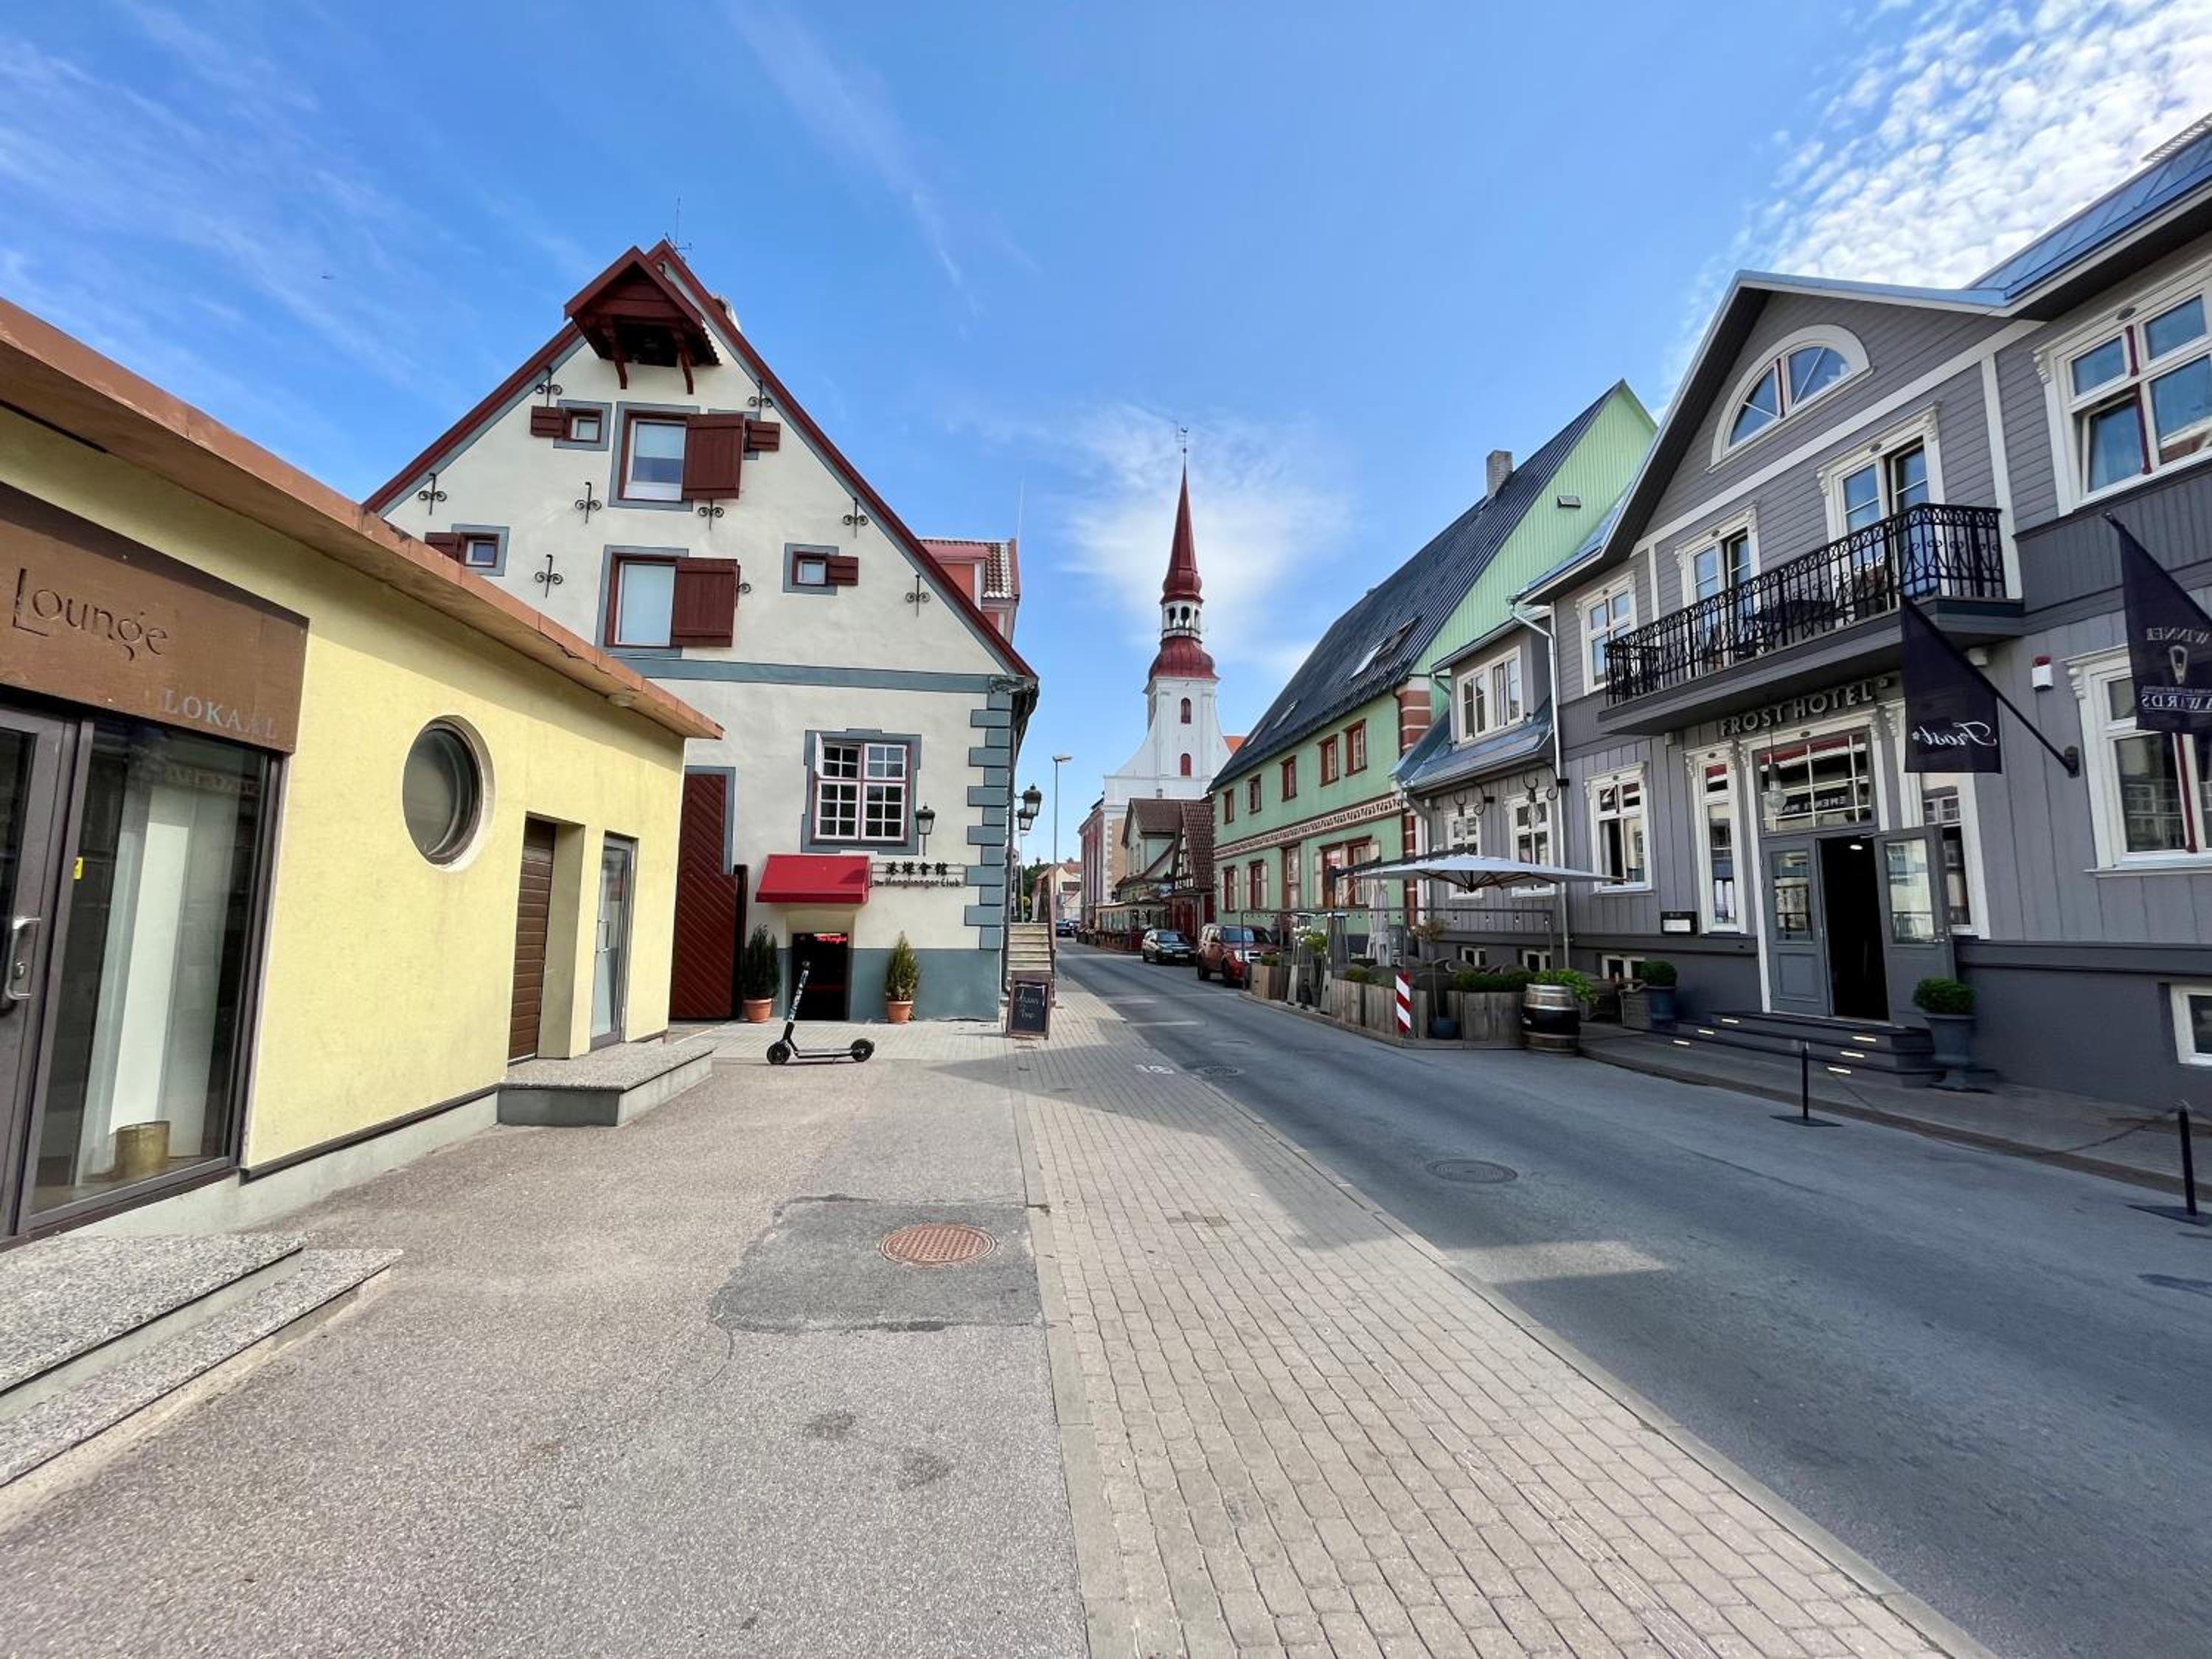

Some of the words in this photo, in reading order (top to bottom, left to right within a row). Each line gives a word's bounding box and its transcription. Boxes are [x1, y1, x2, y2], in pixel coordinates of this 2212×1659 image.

[13, 568, 168, 661] Lounge
[1721, 704, 1784, 737] FROST
[1792, 684, 1873, 720] HOTEL
[940, 878, 961, 887] Club
